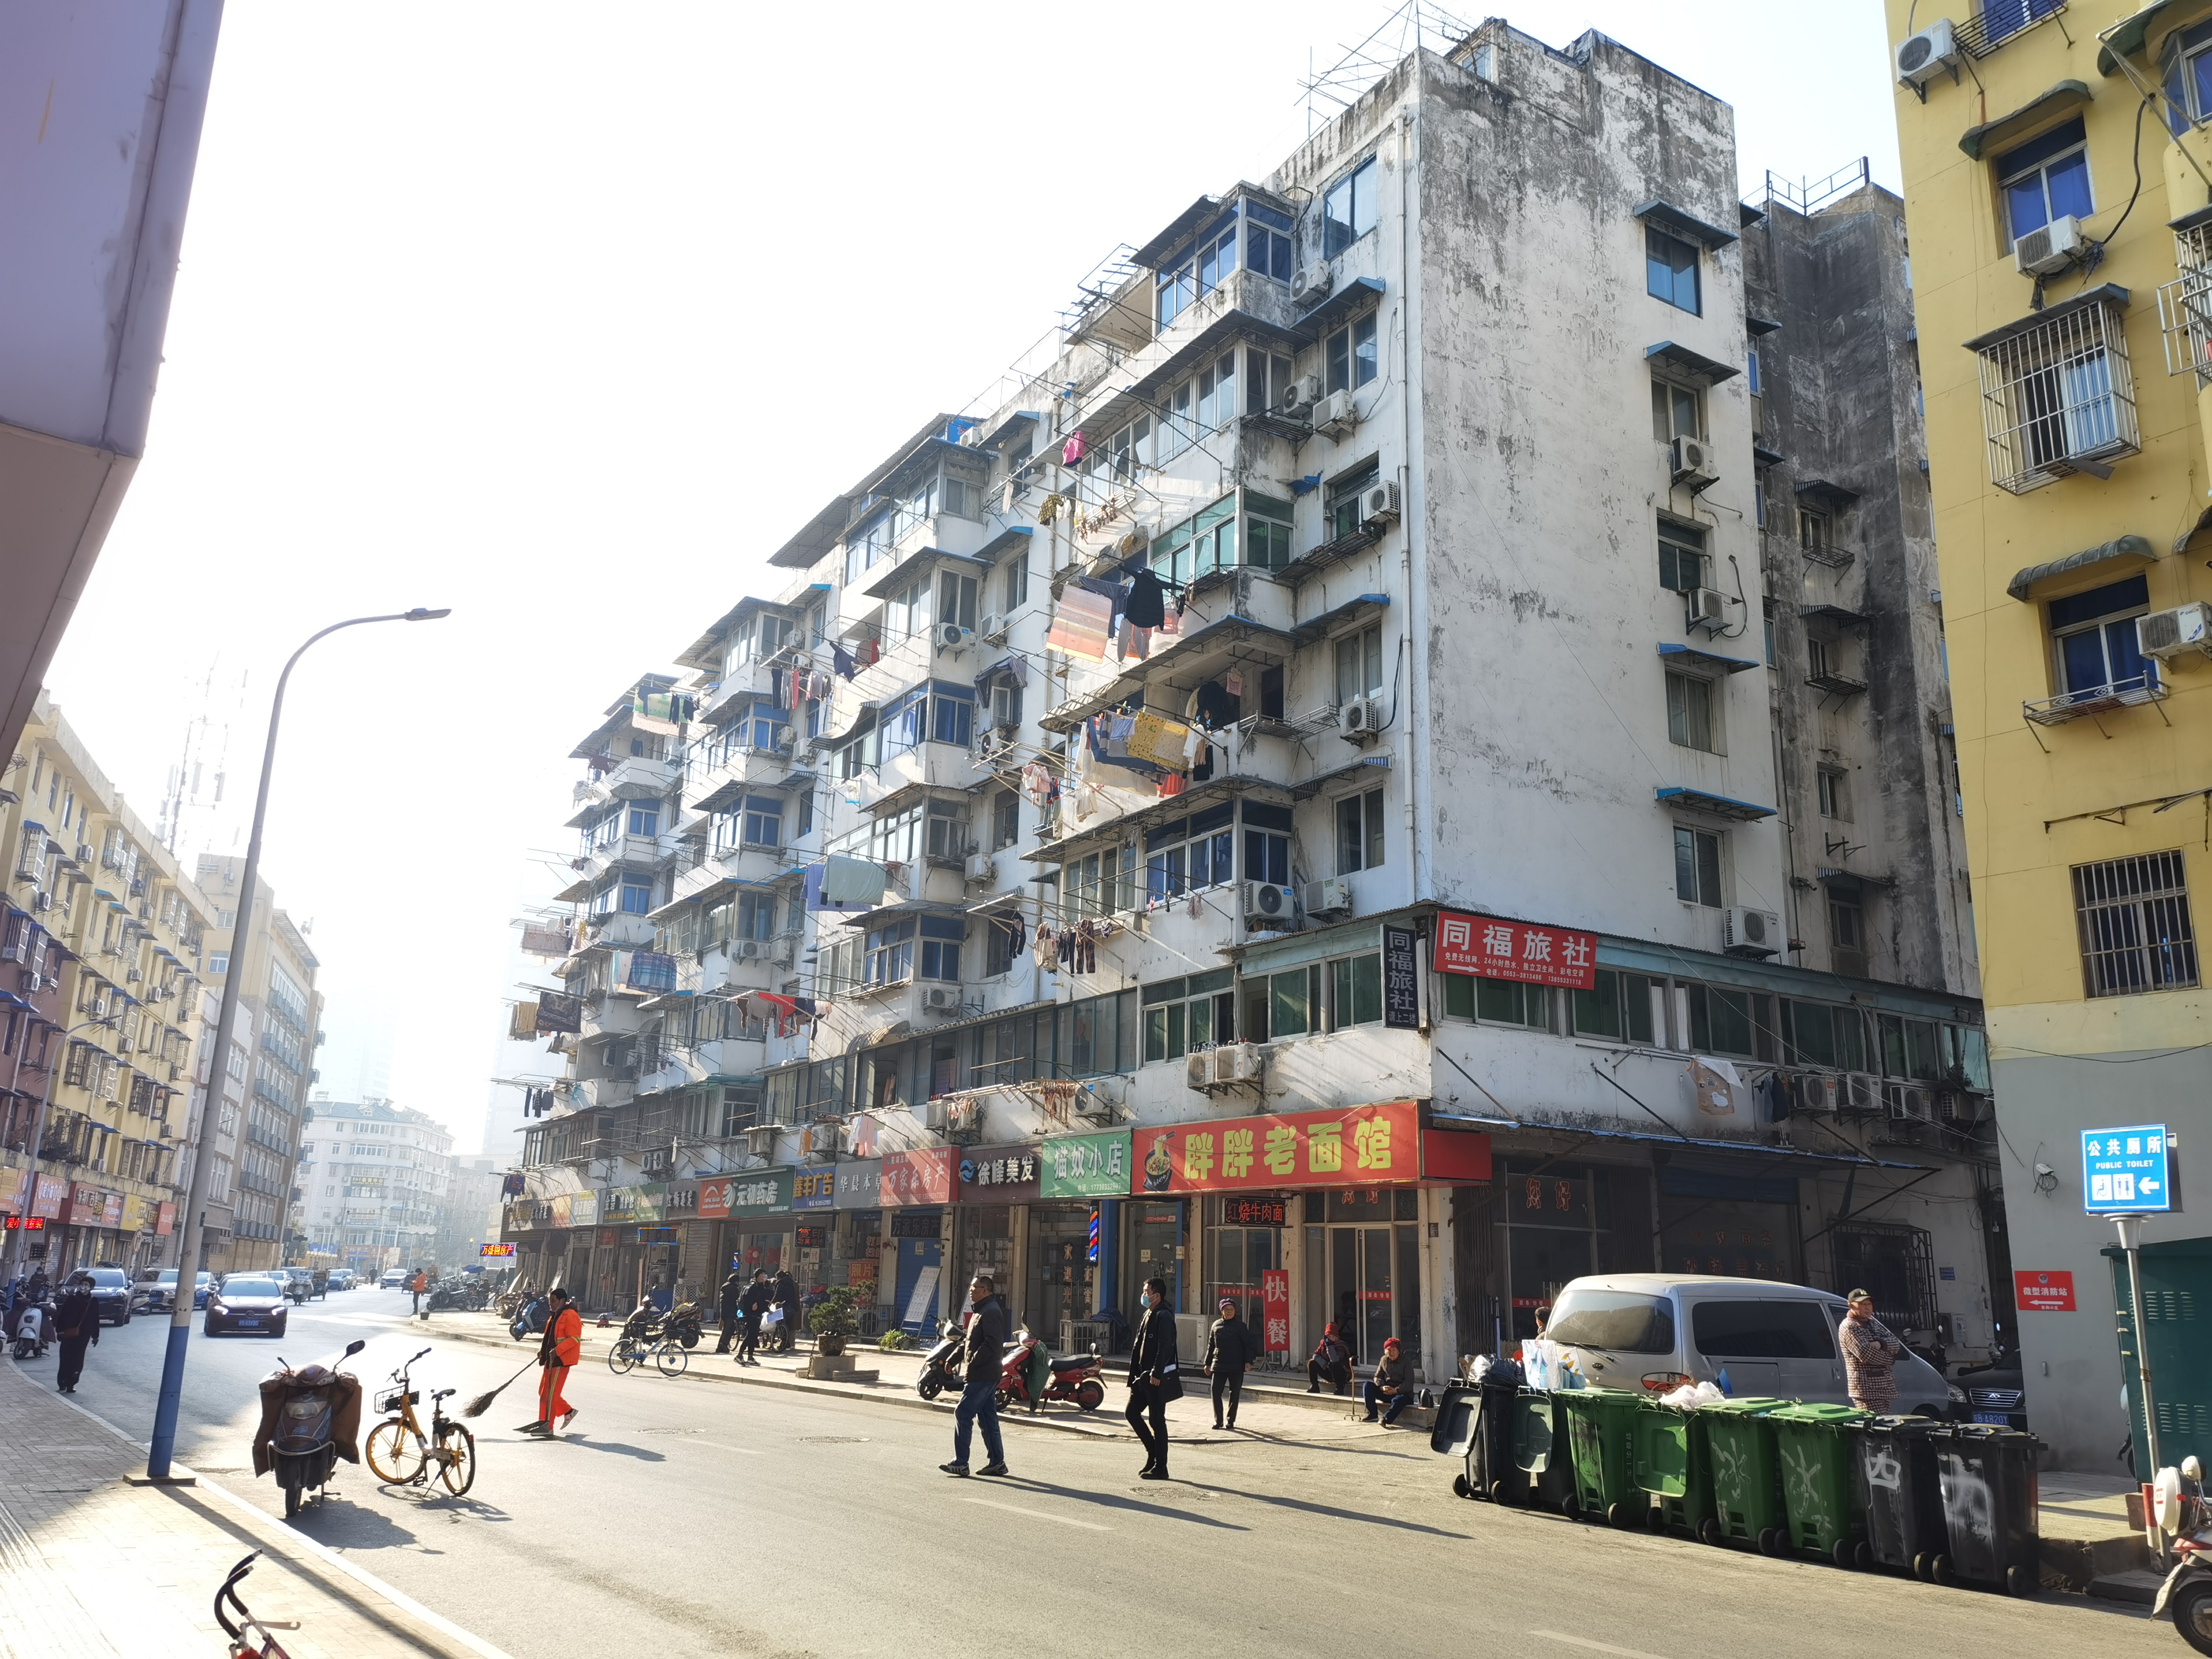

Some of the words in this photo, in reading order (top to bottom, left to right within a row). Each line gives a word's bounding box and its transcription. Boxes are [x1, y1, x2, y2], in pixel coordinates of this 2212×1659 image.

[1442, 919, 1590, 967] 同福旅社
[1388, 932, 1414, 1011] 同福旅社
[1388, 1010, 1417, 1025] 请上二楼
[1184, 1116, 1391, 1181] 胖胖老面馆
[2087, 1135, 2162, 1157] 公共厕所
[976, 1156, 1034, 1186] 徐峰美发
[1054, 1139, 1123, 1181] 猫奴小店
[793, 1171, 834, 1198] 鑫丰广告
[840, 1172, 882, 1193] 华晨本草
[888, 1162, 945, 1191] 万家乐房产
[736, 1179, 779, 1206] 元初药房
[1228, 1202, 1283, 1222] 红烧牛肉面
[892, 1217, 939, 1236] 万家乐房产
[851, 1263, 874, 1277] 照片
[2022, 1287, 2068, 1296] 微型消防站
[1265, 1276, 1288, 1345] 快餐
